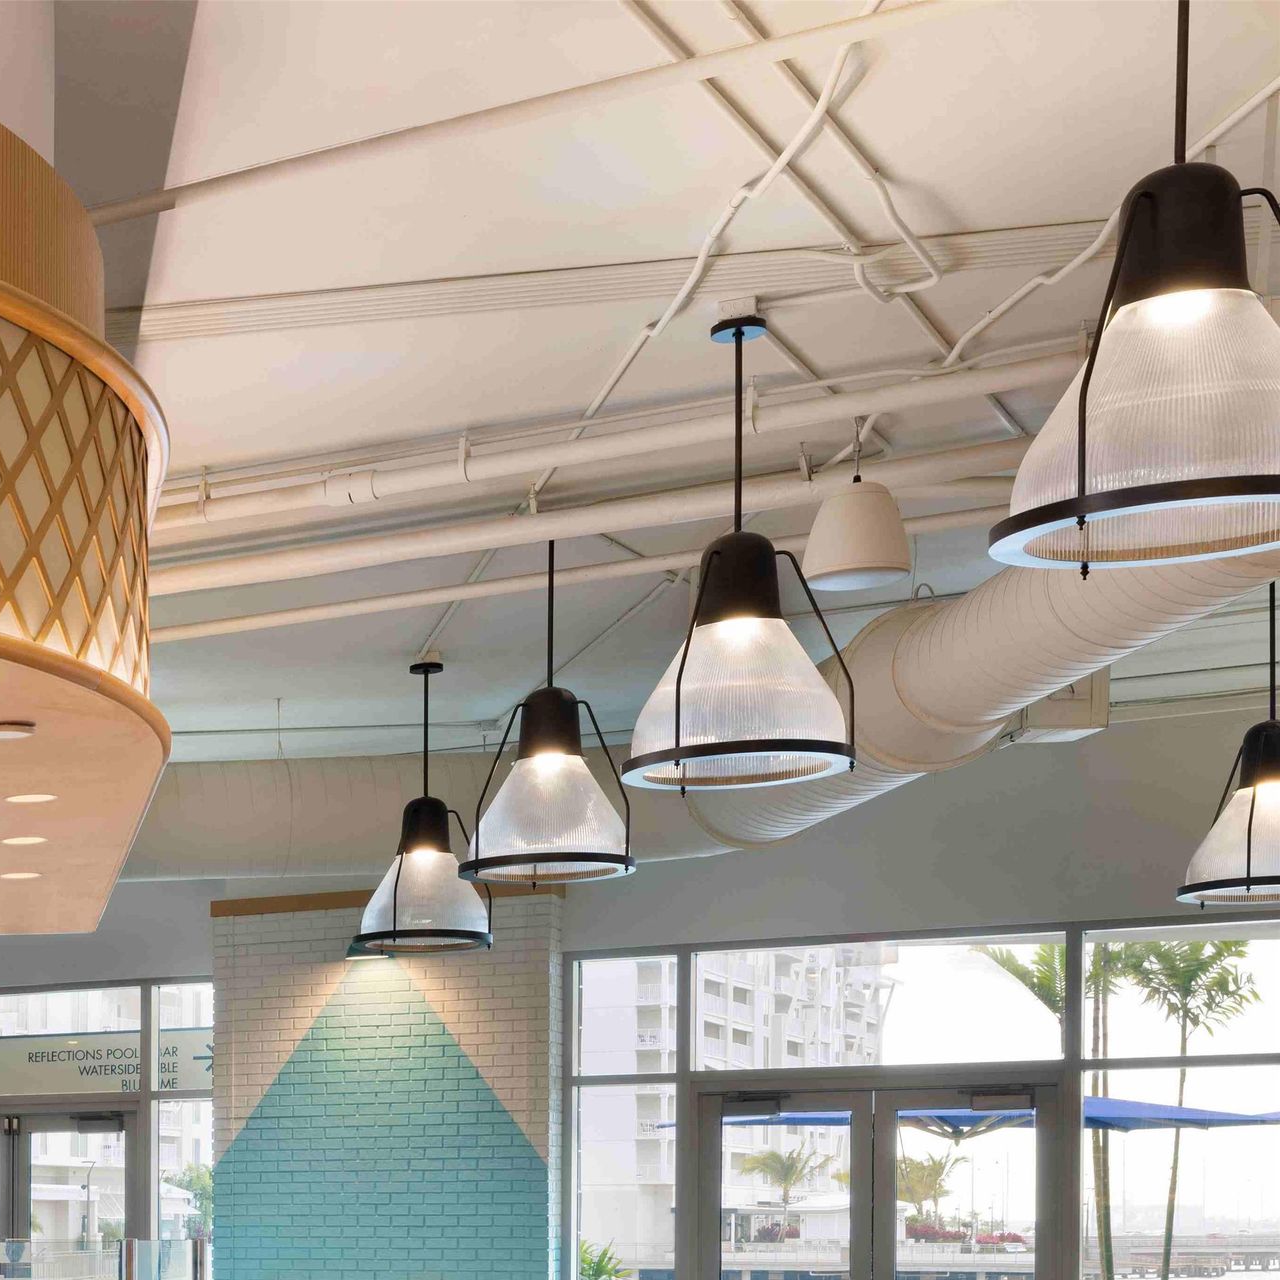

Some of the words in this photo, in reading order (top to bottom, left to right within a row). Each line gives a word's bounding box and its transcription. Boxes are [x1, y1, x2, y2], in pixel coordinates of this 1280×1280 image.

[28, 1050, 102, 1063] REFLECTIONS
[106, 1047, 139, 1060] POOL
[160, 1046, 178, 1057] AR
[78, 1063, 140, 1076] WATERSIDE
